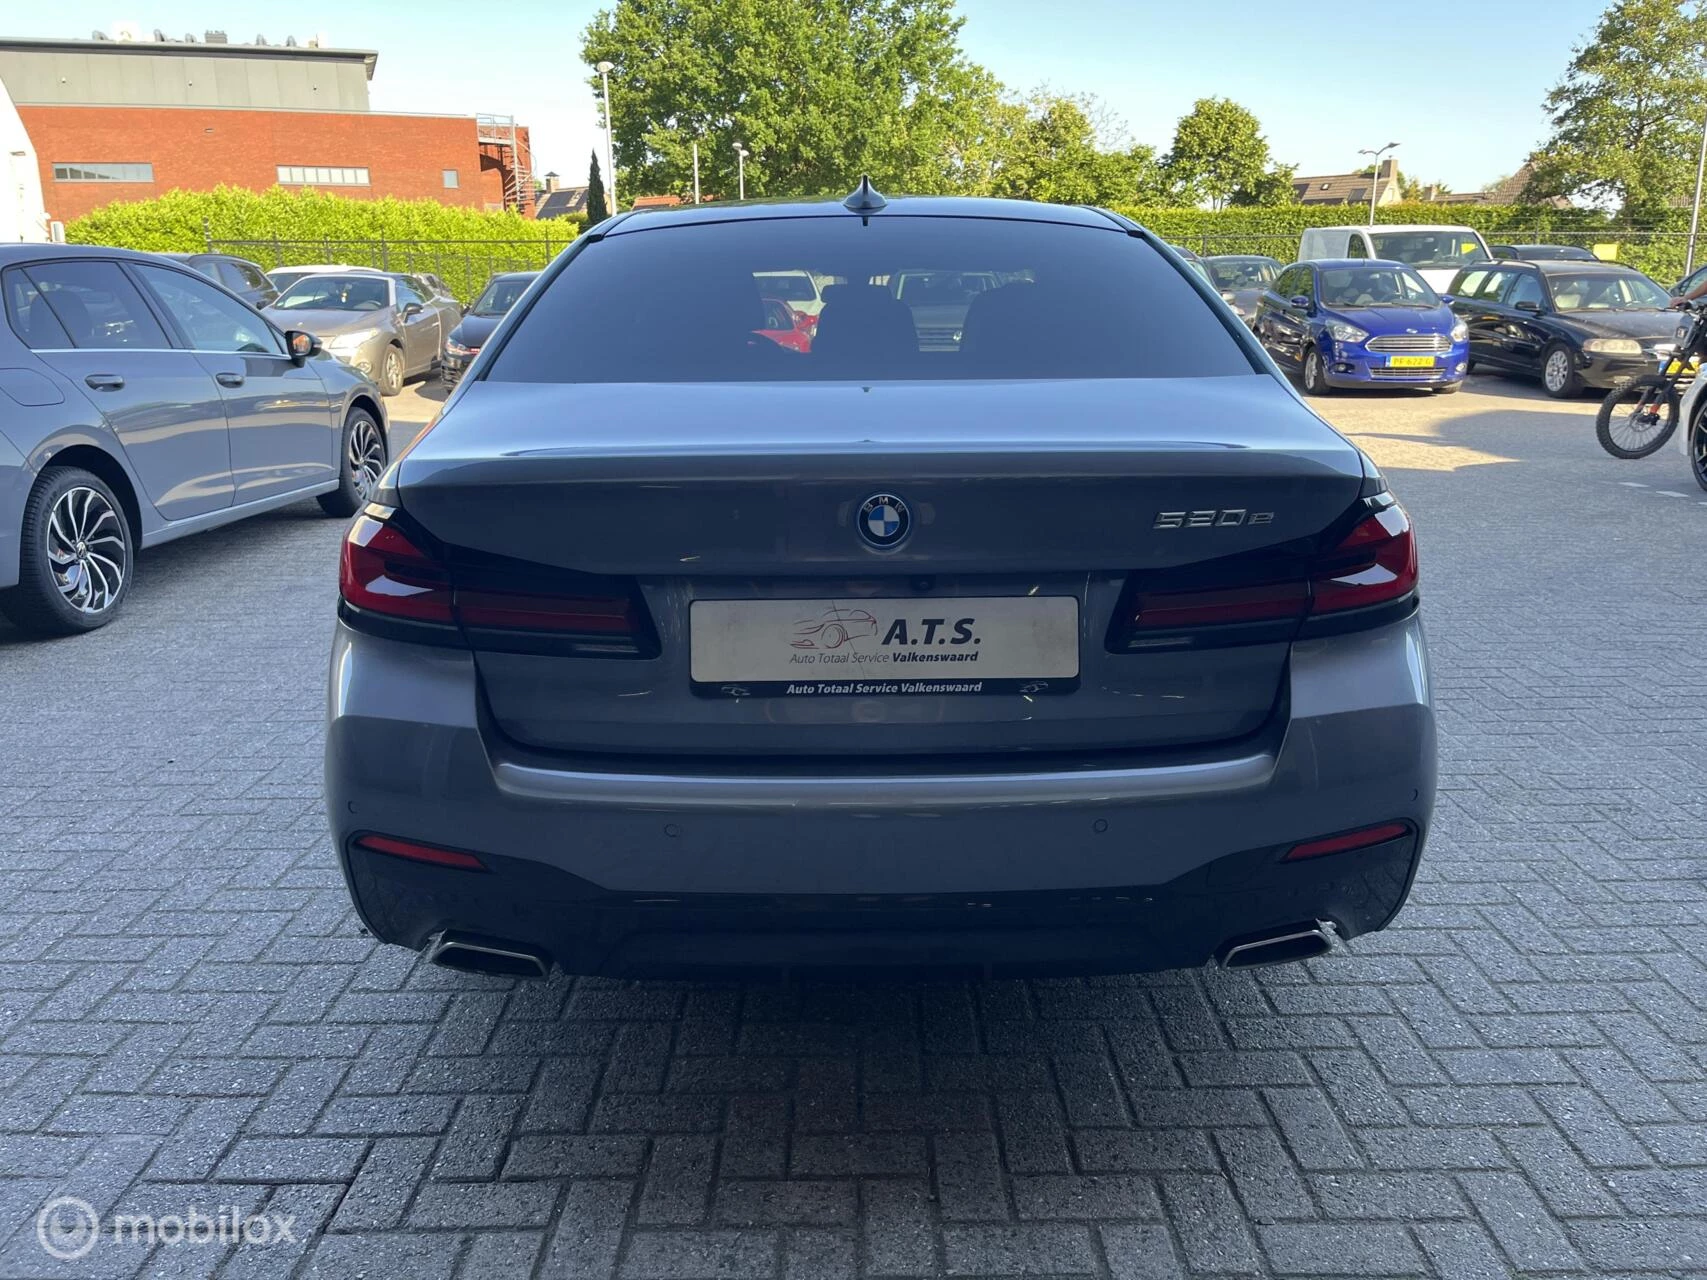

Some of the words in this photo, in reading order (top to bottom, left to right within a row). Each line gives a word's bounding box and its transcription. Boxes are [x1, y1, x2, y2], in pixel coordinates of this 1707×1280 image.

[863, 497, 905, 513] BMW
[1153, 509, 1275, 529] 520e
[881, 618, 981, 645] A.T.S.
[789, 653, 816, 664] Auto
[818, 652, 850, 664] Totaal
[851, 652, 890, 663] Service
[892, 651, 979, 663] Valkenswaard
[786, 684, 815, 694] Auto
[817, 683, 854, 694] Totaal
[855, 683, 898, 693] Service
[901, 682, 983, 693] Valkenswaard
